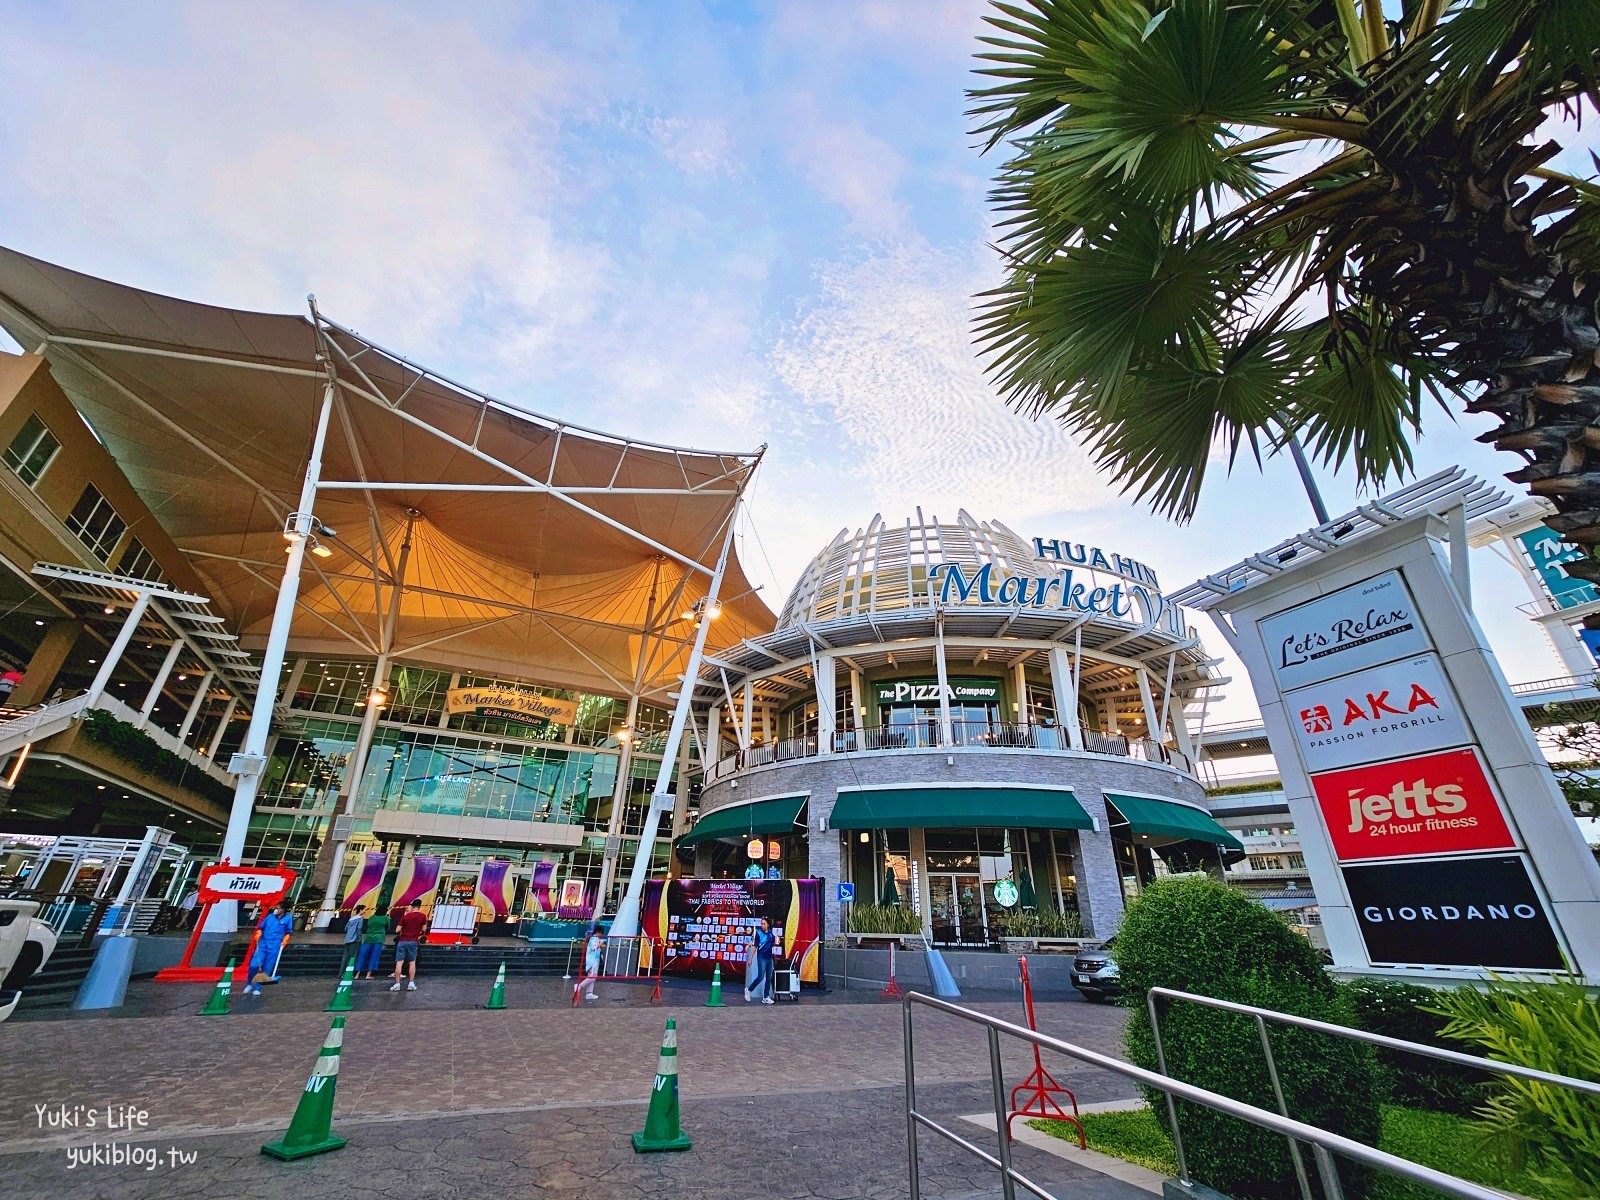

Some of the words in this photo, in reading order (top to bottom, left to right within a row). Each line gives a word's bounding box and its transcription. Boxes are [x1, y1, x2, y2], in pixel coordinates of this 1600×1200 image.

[1032, 536, 1112, 571] HUA
[1111, 552, 1160, 589] HIN
[928, 562, 1132, 618] Market
[1279, 633, 1330, 671] Let's
[1331, 608, 1409, 644] Relax
[1331, 640, 1363, 653] ORIGINAL
[1365, 633, 1387, 642] SINCE
[462, 692, 516, 707] Market
[517, 697, 562, 716] Village
[880, 690, 895, 699] The
[895, 682, 957, 701] PIZZA
[956, 687, 996, 697] Company
[1343, 683, 1440, 726] AKA
[1310, 731, 1365, 748] PASSION
[1348, 778, 1468, 833] jetts
[1369, 825, 1388, 837] 24
[1389, 822, 1423, 835] hour
[1425, 816, 1479, 831] fitness
[912, 860, 920, 903] STARBUCKS
[1363, 904, 1536, 923] GIORDANO
